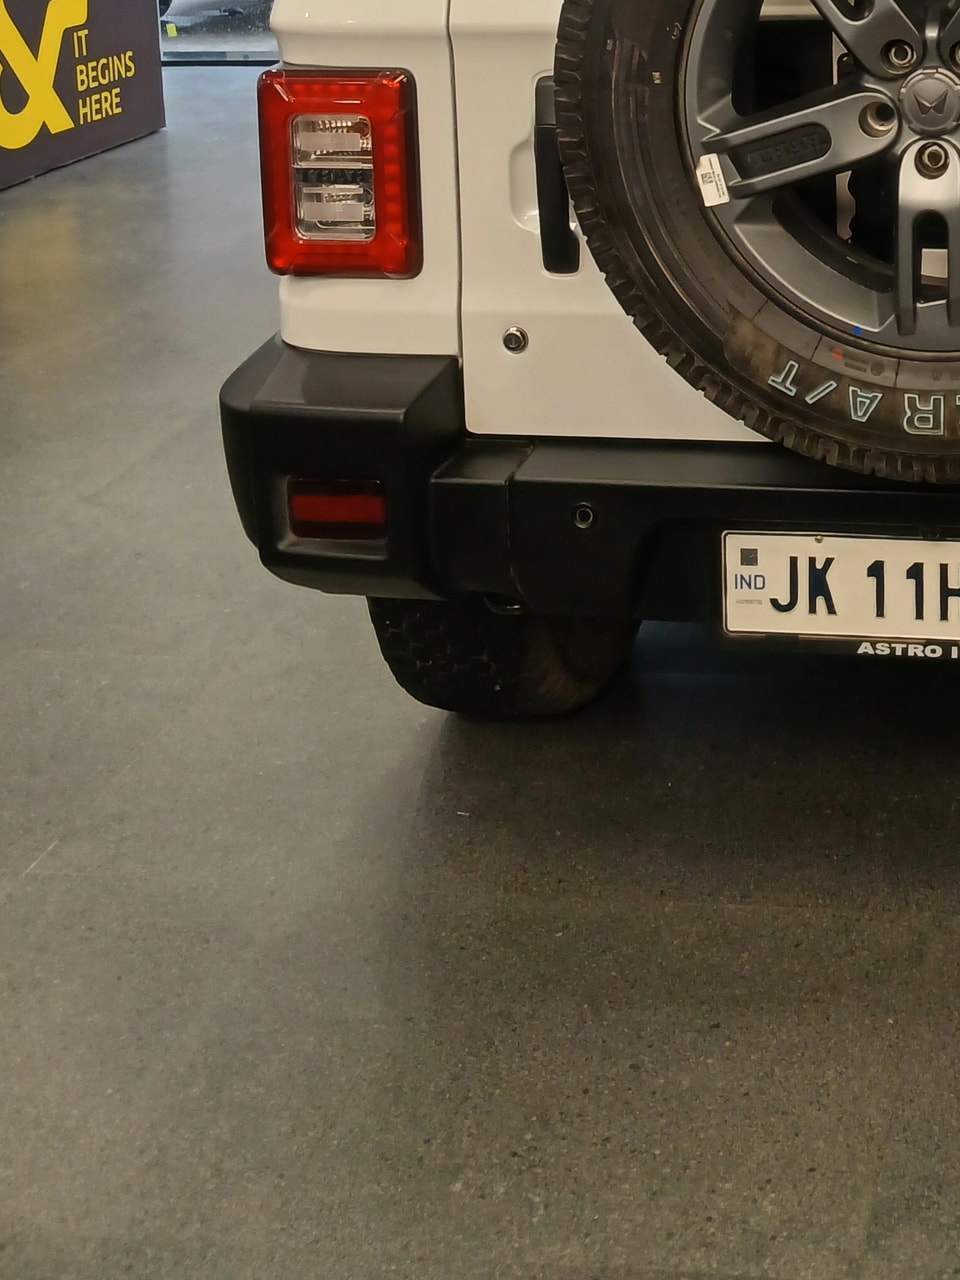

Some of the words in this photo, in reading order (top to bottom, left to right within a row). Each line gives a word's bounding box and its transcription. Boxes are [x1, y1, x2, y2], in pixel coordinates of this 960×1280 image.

[74, 29, 89, 58] IT
[76, 51, 135, 92] BEGINS
[79, 87, 122, 125] HERE
[767, 359, 884, 423] A/T
[734, 574, 766, 590] IND
[769, 556, 837, 616] JK
[857, 642, 943, 658] ASTRO
